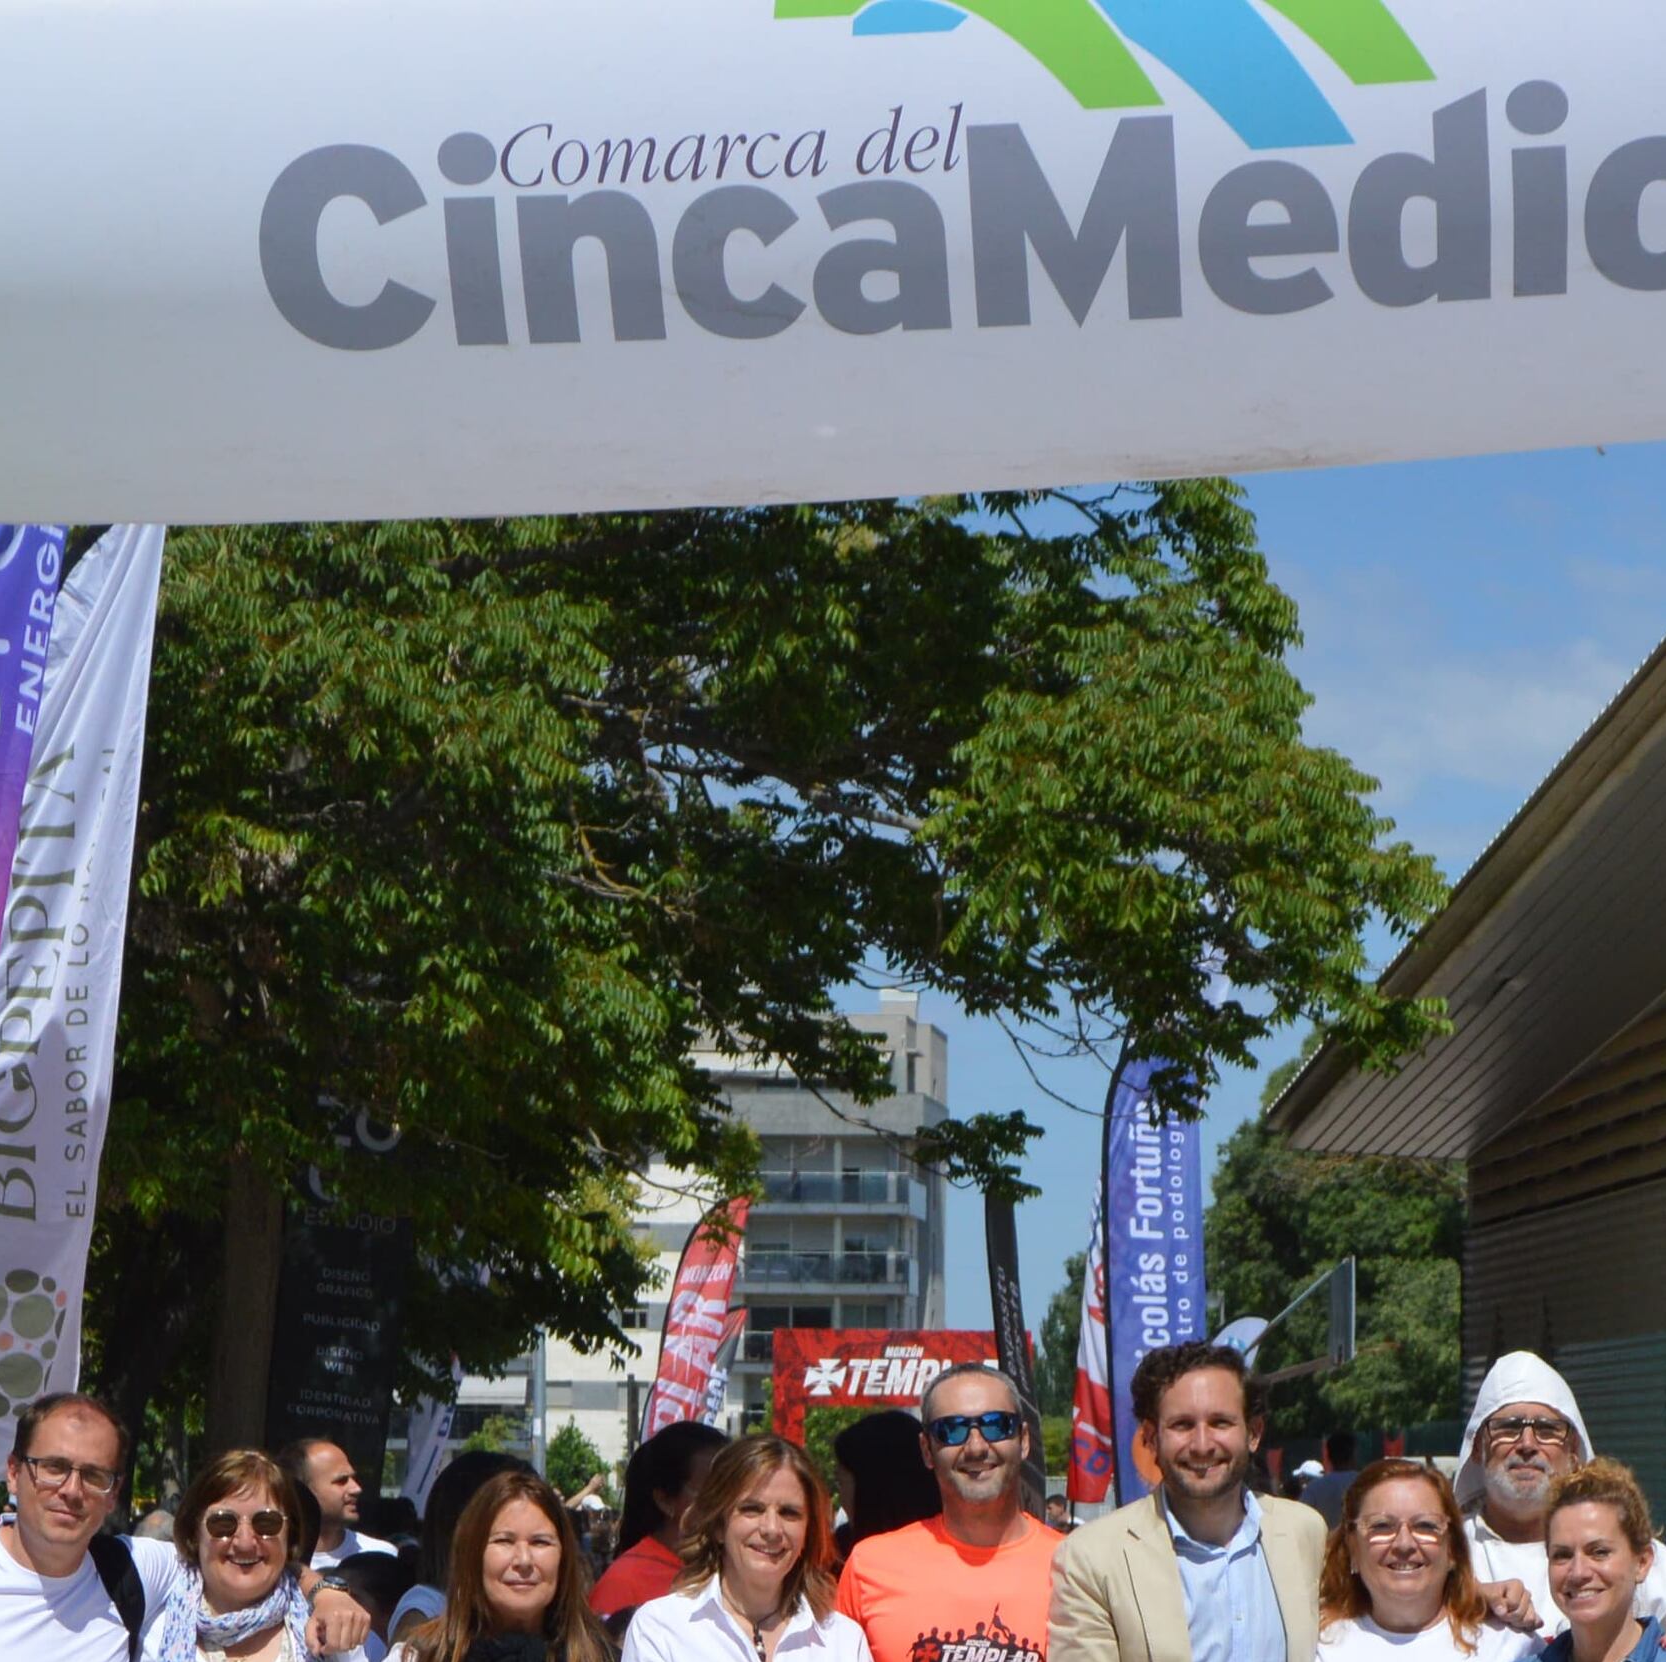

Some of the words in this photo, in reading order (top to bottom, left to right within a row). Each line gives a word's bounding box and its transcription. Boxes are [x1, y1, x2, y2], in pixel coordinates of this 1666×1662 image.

[497, 121, 830, 190] Comarca
[853, 102, 967, 177] del
[67, 924, 89, 967] LO
[66, 985, 89, 1025] DE
[65, 1045, 89, 1161] SABOR
[67, 1180, 86, 1218] EL
[303, 1206, 397, 1234] ESUDIO
[1173, 1253, 1188, 1285] de
[1131, 1252, 1171, 1372] icolás
[1176, 1299, 1193, 1336] tro
[847, 1358, 1000, 1397] TEMP
